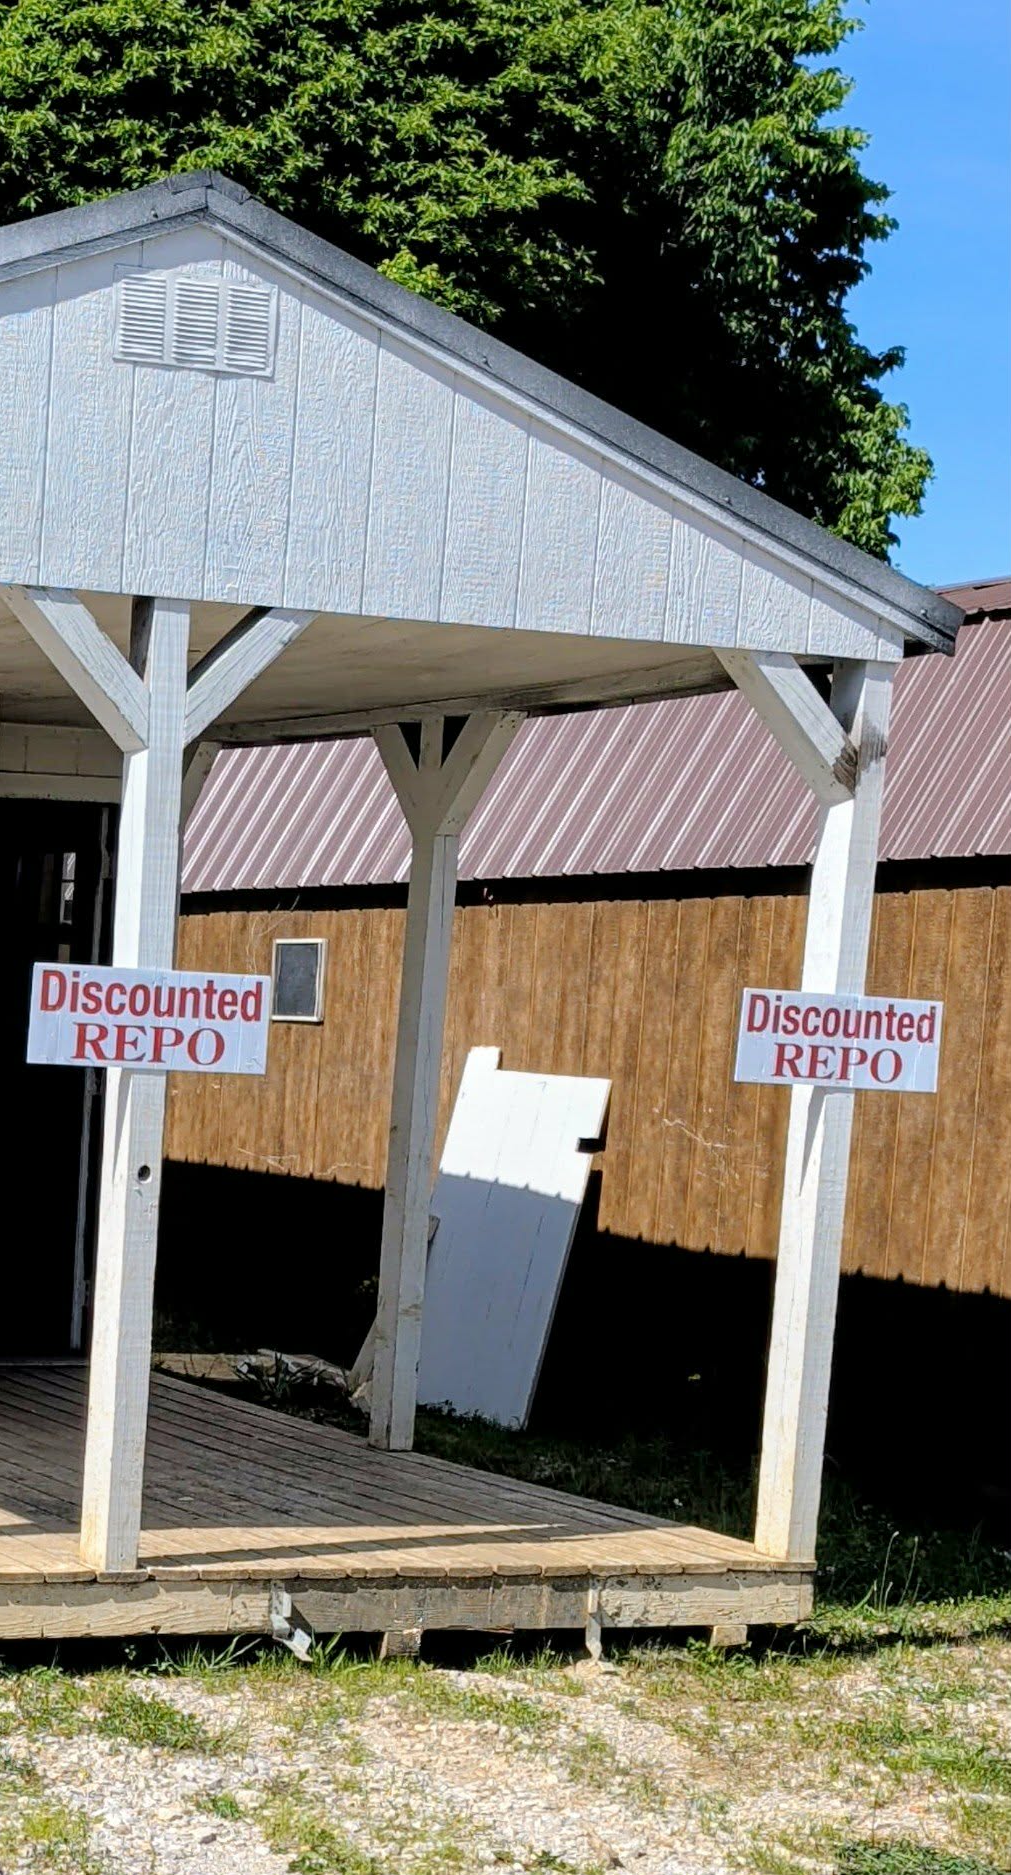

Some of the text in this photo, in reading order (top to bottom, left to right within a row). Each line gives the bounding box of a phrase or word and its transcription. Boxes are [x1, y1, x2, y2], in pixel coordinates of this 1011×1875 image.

[40, 969, 263, 1022] Discounted
[747, 994, 936, 1043] Discounted
[70, 1022, 225, 1066] REPO
[771, 1042, 903, 1083] REPO
